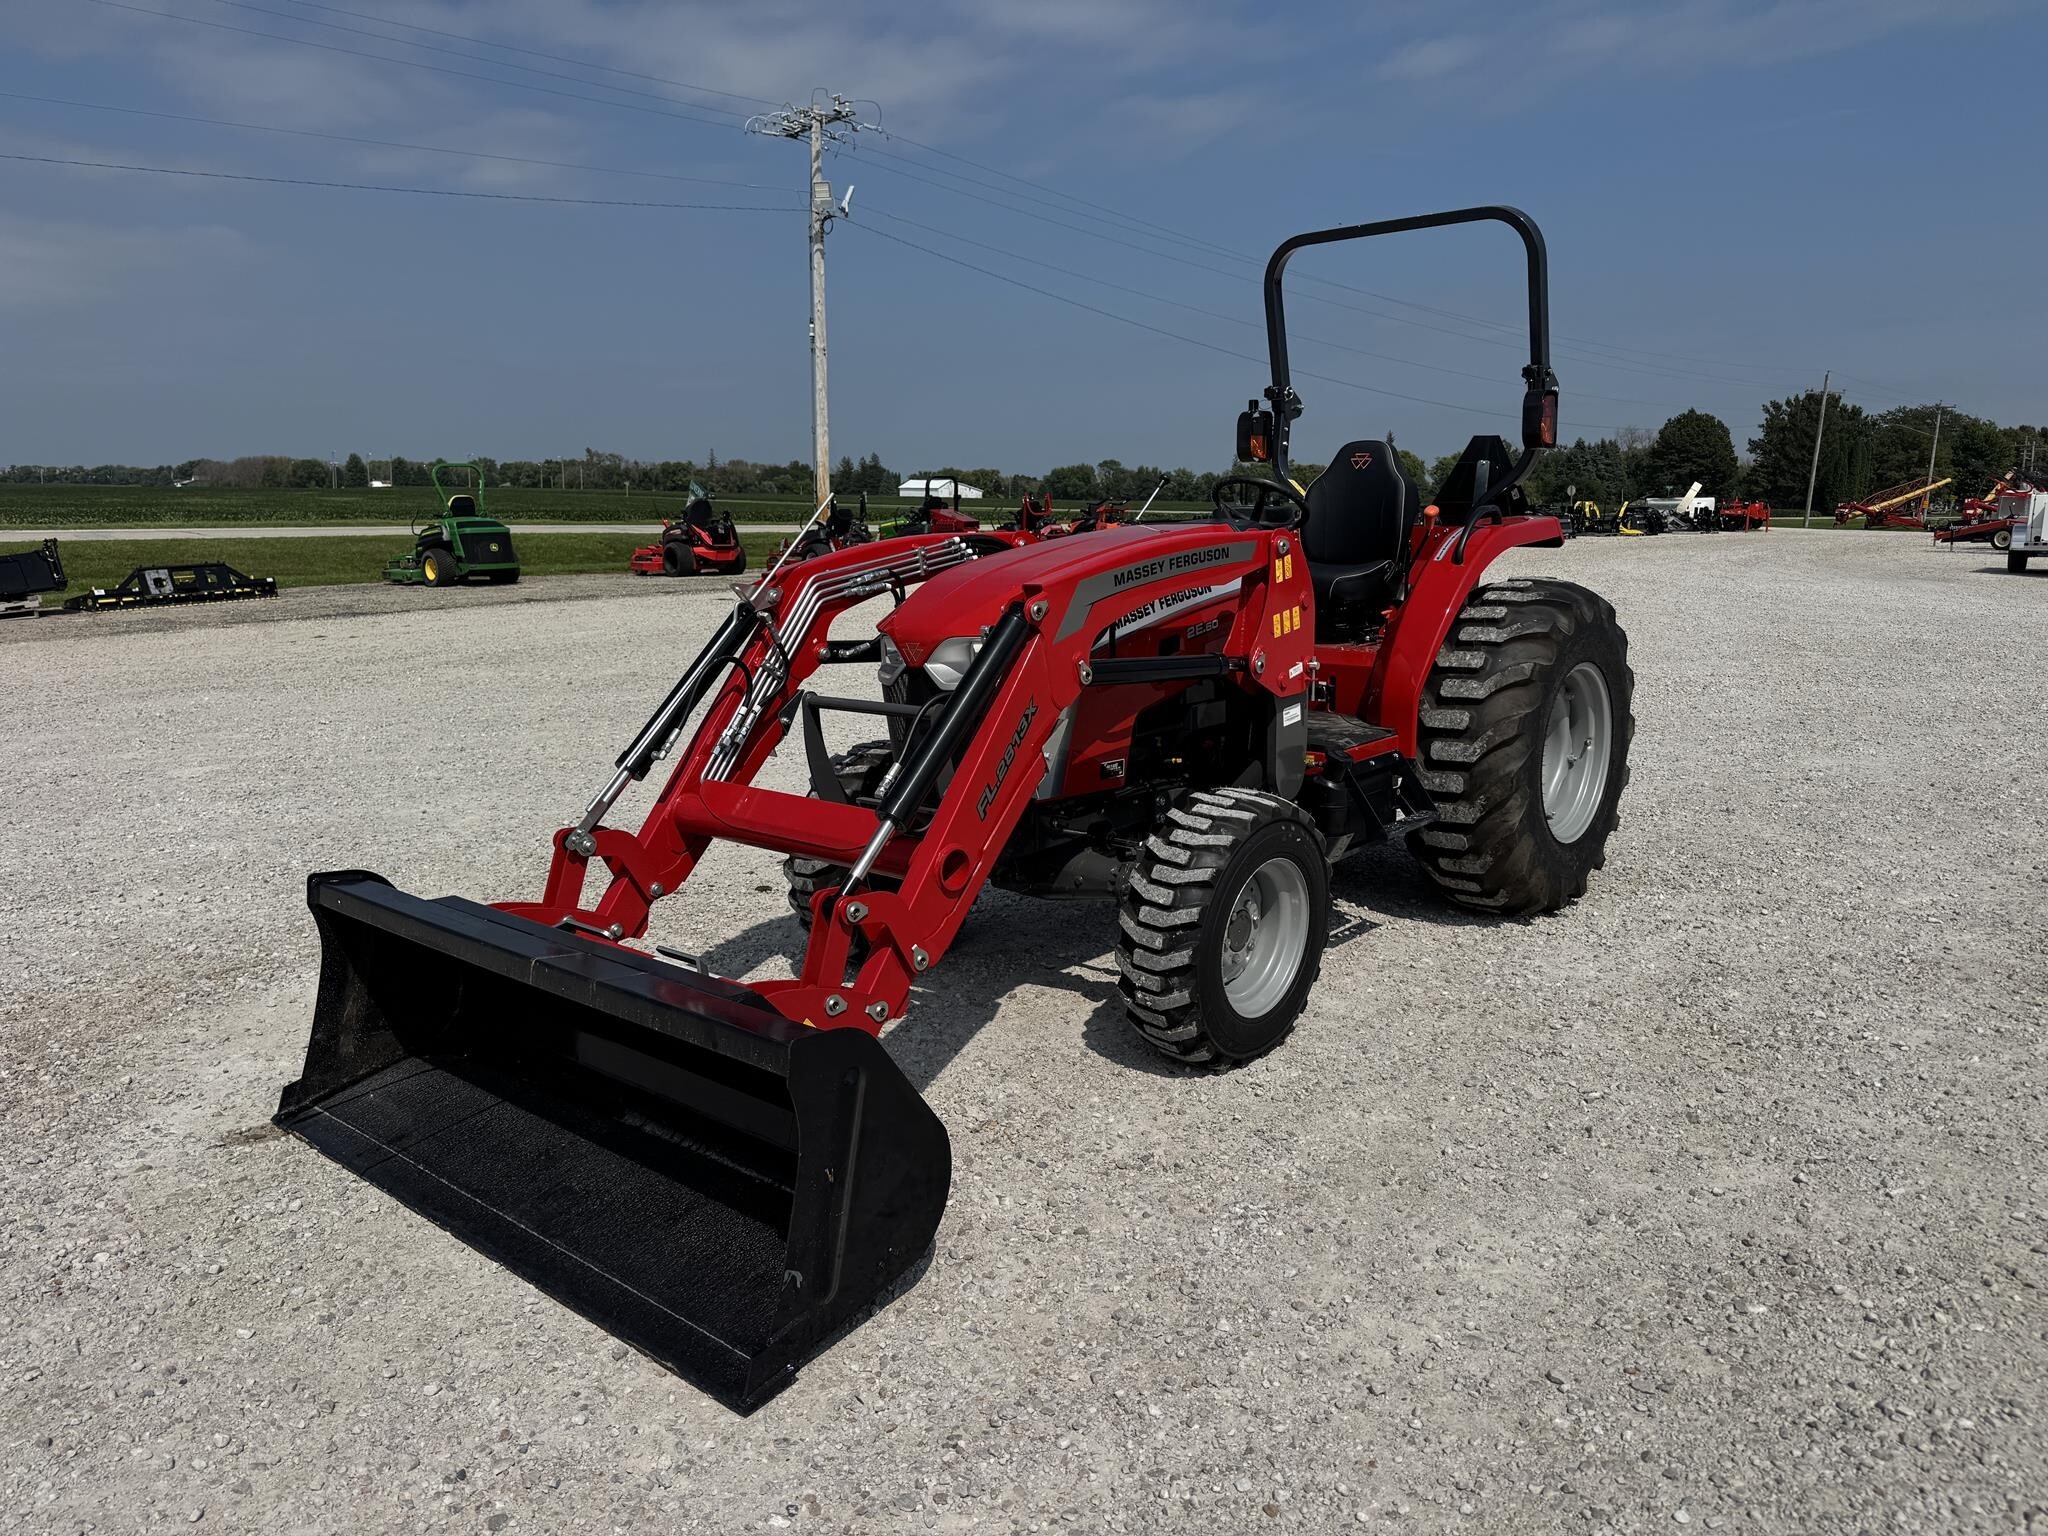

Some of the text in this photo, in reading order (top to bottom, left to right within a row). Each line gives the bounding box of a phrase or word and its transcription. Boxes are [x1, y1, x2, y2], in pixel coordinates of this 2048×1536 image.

[1113, 546, 1230, 587] MASSEY FERGUSON
[1114, 585, 1212, 631] MASSEY FERGUSON
[1186, 619, 1219, 639] 2E.60
[976, 695, 1038, 822] FL.2813X
